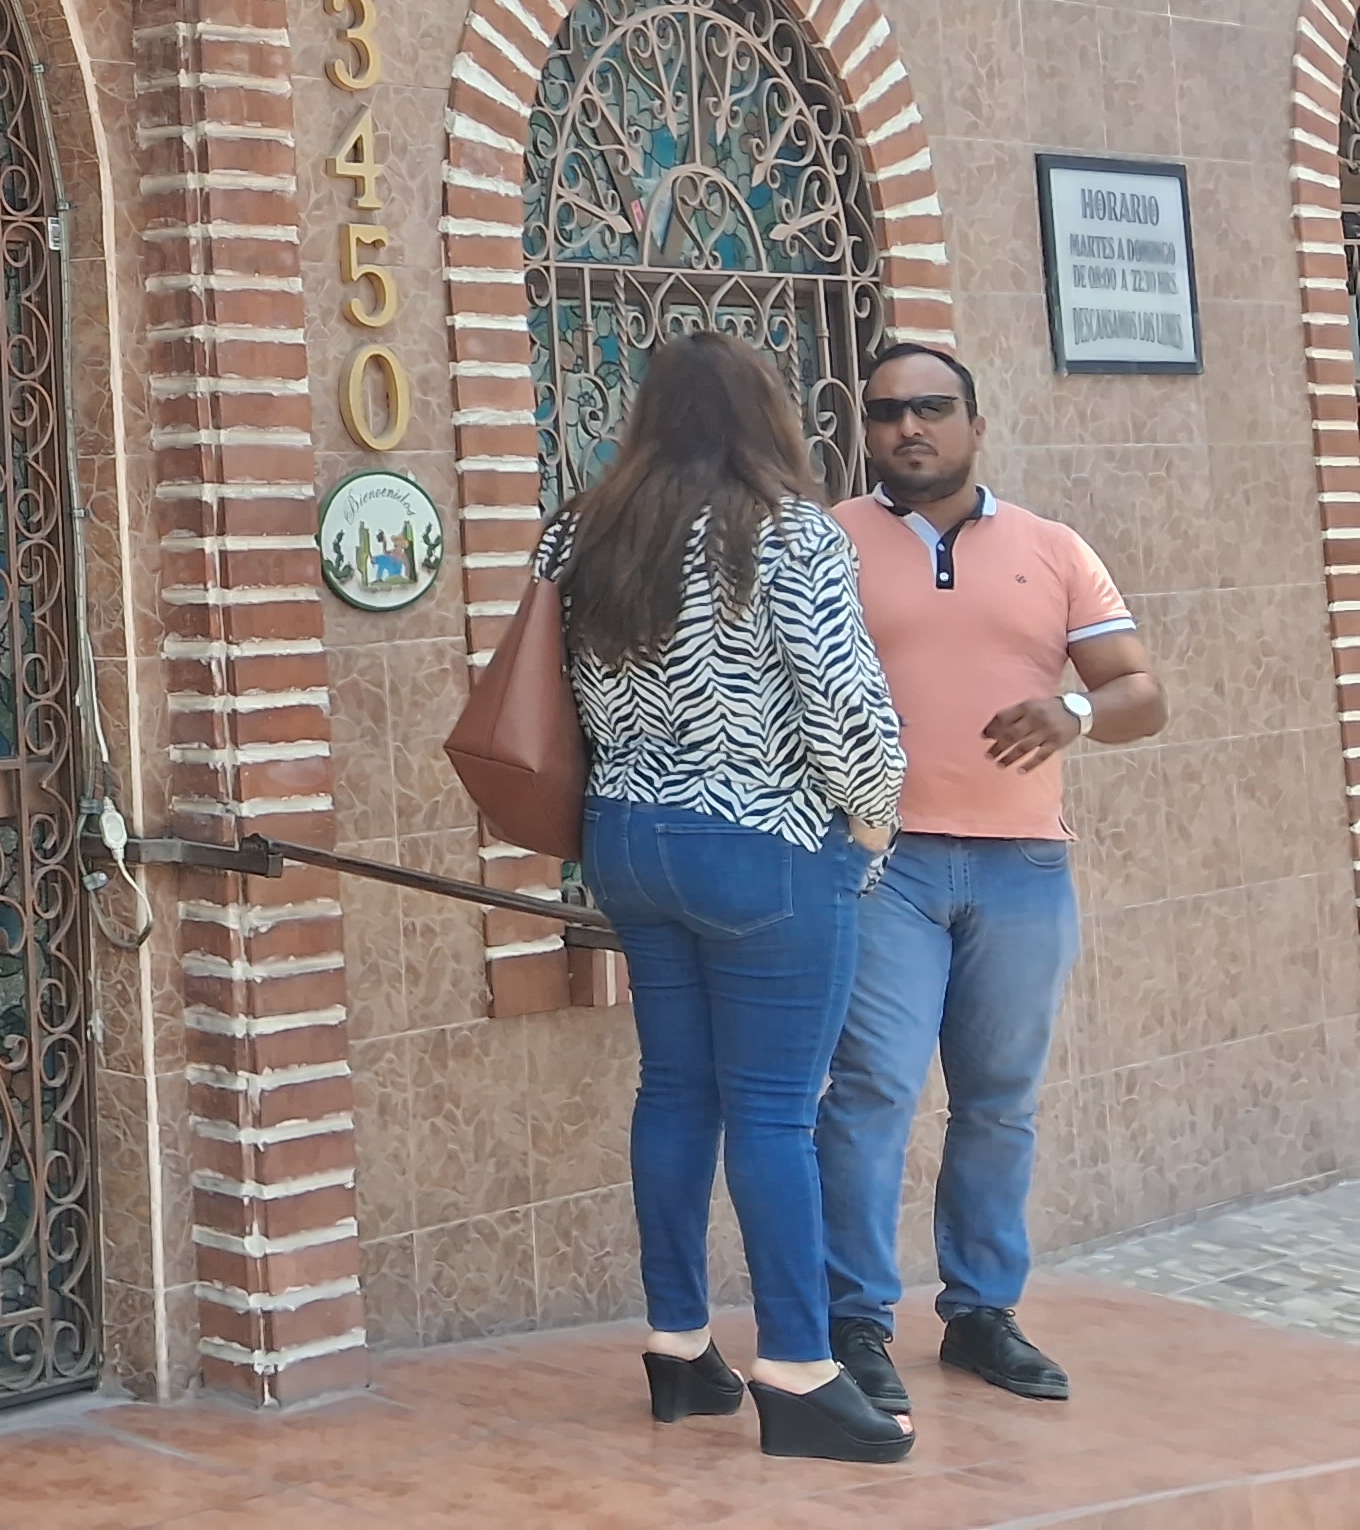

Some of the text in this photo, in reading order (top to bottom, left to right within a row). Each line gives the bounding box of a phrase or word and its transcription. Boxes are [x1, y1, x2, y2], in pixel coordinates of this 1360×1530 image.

[1080, 188, 1160, 227] HORARIO
[1069, 232, 1115, 260] MARTES
[1117, 237, 1126, 261] A
[1072, 264, 1087, 289] DE
[1121, 267, 1129, 292] A
[342, 486, 417, 526] Bienvenidos
